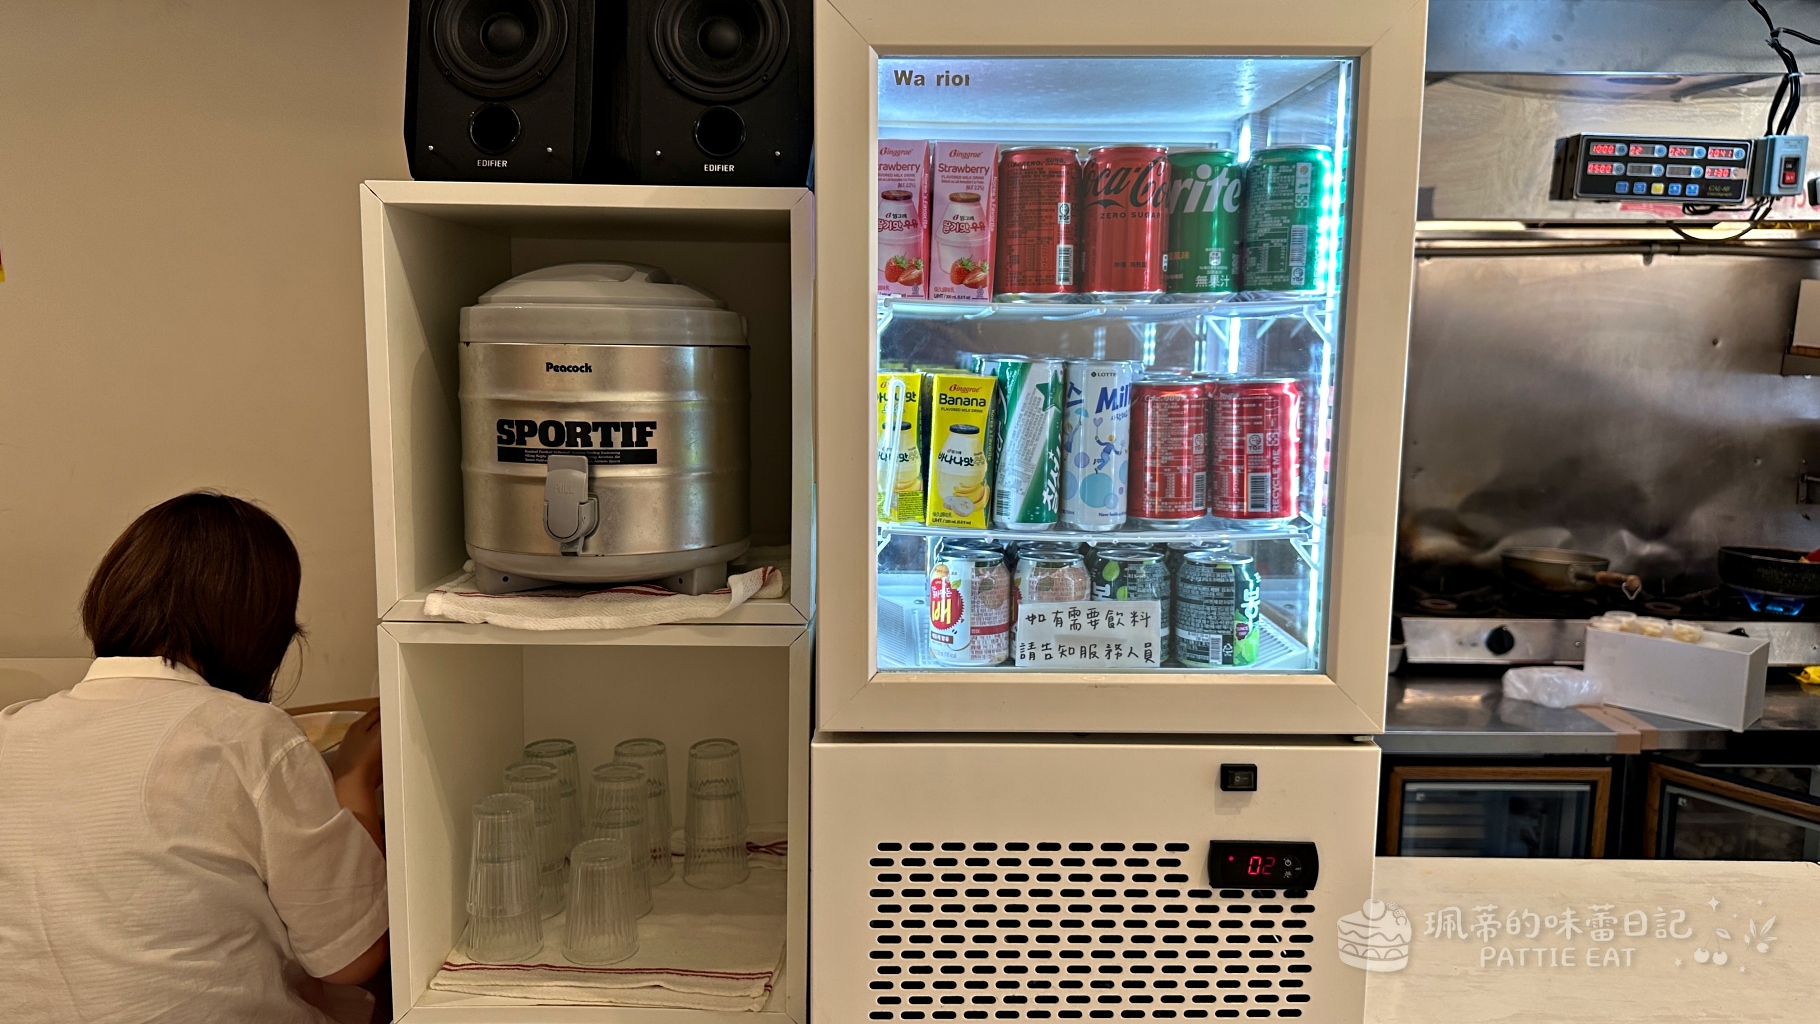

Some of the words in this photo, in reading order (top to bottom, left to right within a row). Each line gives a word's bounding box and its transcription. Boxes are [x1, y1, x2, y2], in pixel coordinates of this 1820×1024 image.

[477, 159, 508, 168] EDIFIER
[704, 164, 735, 173] EDIFIER
[878, 162, 921, 173] rawberry
[938, 163, 990, 176] Strawberry
[1195, 274, 1231, 288] 無果汁
[546, 362, 593, 373] Peacock
[949, 384, 981, 394] Binggrae
[938, 393, 987, 407] Banana
[496, 419, 657, 448] SPORTIF
[1272, 451, 1280, 466] ME
[555, 483, 574, 494] PULL
[1272, 466, 1280, 512] RECYCLE
[1025, 606, 1151, 631] 如有需要飲料
[1019, 642, 1155, 664] 請告知服務人員
[1247, 856, 1276, 875] 02
